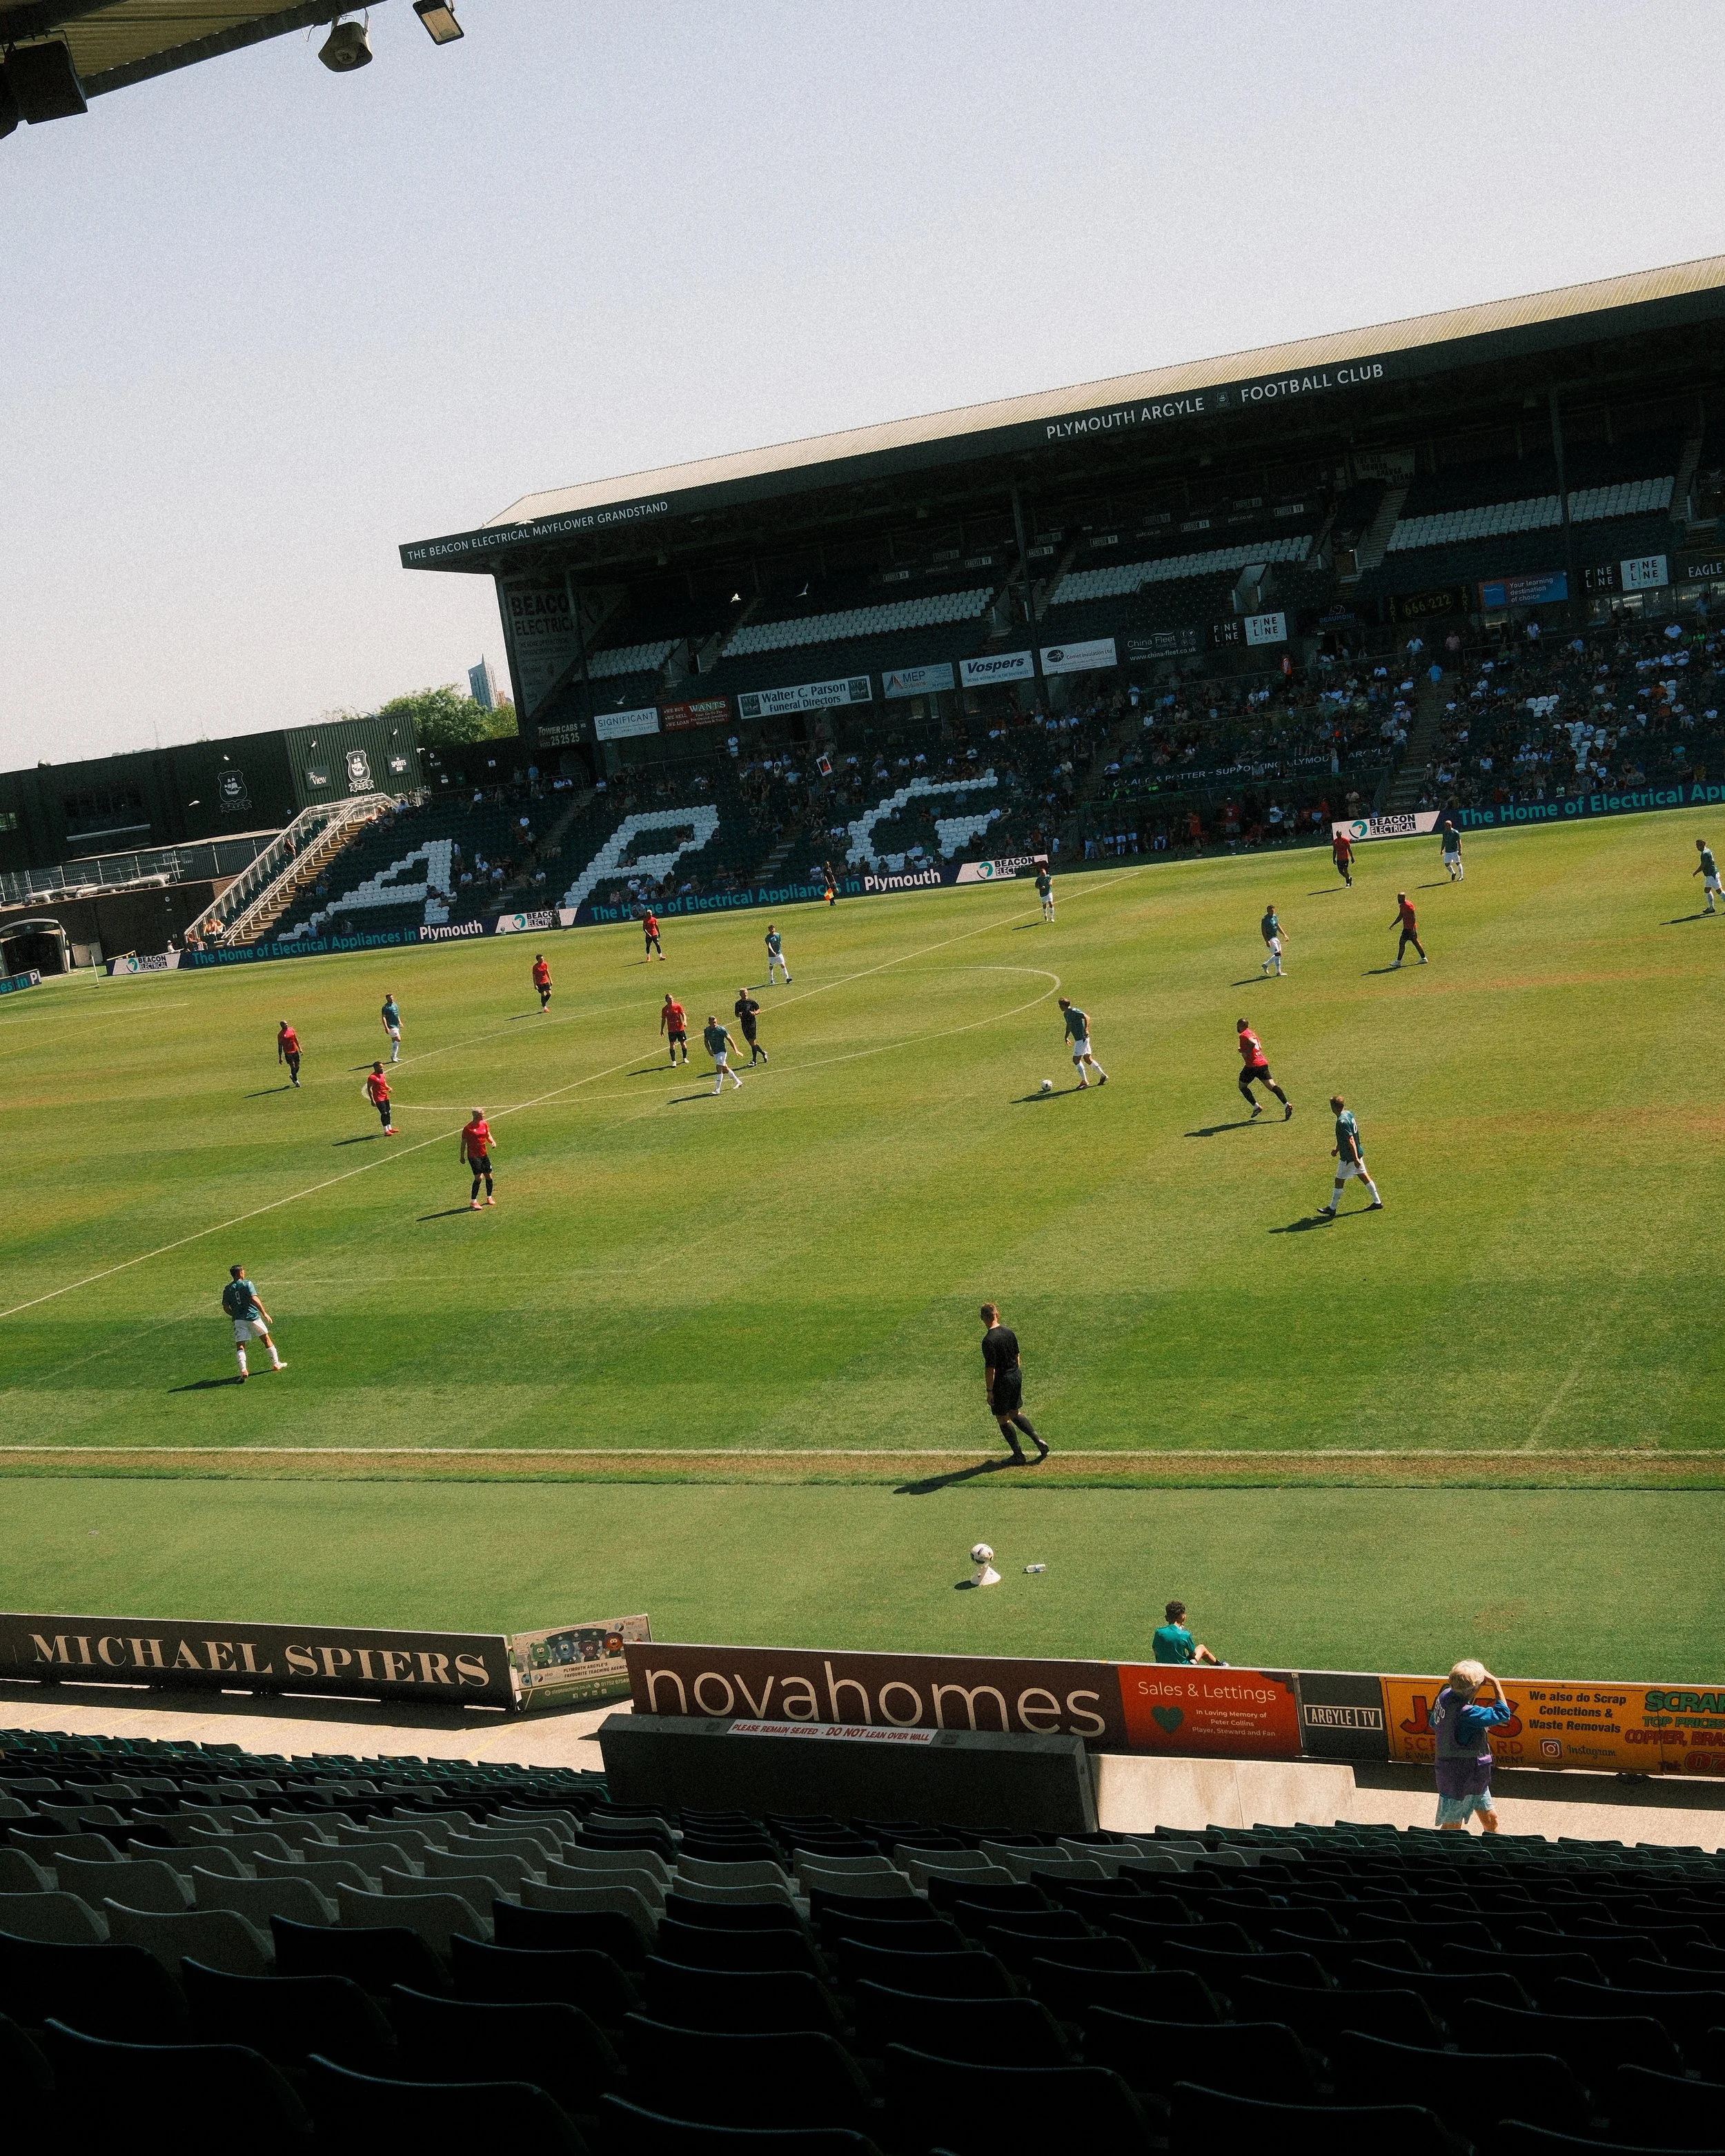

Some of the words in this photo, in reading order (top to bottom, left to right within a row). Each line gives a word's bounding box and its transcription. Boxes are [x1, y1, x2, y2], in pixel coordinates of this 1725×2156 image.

[1046, 409, 1136, 439] PLYMOUTH
[1141, 396, 1205, 422] ARGYLE
[1241, 373, 1332, 403] FOOTBALL
[1337, 363, 1384, 384] CLUB
[407, 548, 427, 560] THE
[429, 540, 469, 556] BEACON
[472, 528, 530, 548] ELECTRICAL
[533, 515, 594, 536] MAYFLOWER
[597, 501, 668, 524] GRANDSTAND
[1688, 562, 1723, 578] EAGLE
[1509, 582, 1525, 590] Your
[1526, 576, 1554, 589] learning
[1510, 585, 1547, 596] destination
[1460, 586, 1468, 612] TAXI
[1519, 593, 1541, 602] choice
[1388, 597, 1397, 623] TAXI
[1127, 639, 1152, 648] China
[1154, 635, 1176, 644] Fleet
[1082, 650, 1104, 658] Insulation
[1130, 646, 1197, 661] www.china-fleet.co.uk
[967, 657, 1025, 674] Vospers
[903, 671, 926, 683] MEP
[762, 691, 795, 703] Walter
[798, 687, 809, 698] C.
[811, 682, 847, 696] Parson
[689, 700, 727, 713] WANTS
[769, 701, 800, 713] Funeral
[803, 695, 842, 708] Directors
[598, 712, 654, 727] SIGNIFICANT
[538, 726, 561, 737] TOWER
[561, 723, 578, 733] CABS
[550, 735, 560, 746] 25
[560, 733, 570, 744] 25
[570, 732, 580, 743] 25
[312, 775, 327, 785] View
[1459, 809, 1494, 826] The
[1500, 804, 1558, 822] Home
[1564, 795, 1585, 815] of
[1590, 788, 1684, 812] Electrical
[1369, 813, 1416, 827] BEACON
[1370, 822, 1417, 835] ELECTRICAL
[994, 856, 1036, 868] BEACON
[591, 905, 618, 921] The
[622, 900, 663, 918] Hme
[667, 897, 682, 912] of
[686, 889, 753, 911] Electrical
[759, 883, 842, 903] Appliancs
[845, 877, 861, 893] in
[864, 869, 941, 892] Plymouth
[192, 951, 216, 965] The
[218, 946, 254, 962] Home
[257, 944, 269, 958] of
[273, 937, 328, 956] Electrical
[332, 931, 400, 950] Appliances
[404, 927, 416, 941] in
[420, 920, 483, 941] Plymouth
[138, 954, 167, 964] BEACON
[139, 961, 168, 971] ELECTRICAL
[16, 976, 28, 989] in
[28, 1634, 273, 1674] MICHAEL
[284, 1643, 490, 1688] SPIERS
[563, 1665, 586, 1673] PLYMOUTH
[645, 1661, 1106, 1737] novahomes
[1138, 1681, 1183, 1697] Sales
[1187, 1683, 1200, 1697] &
[1204, 1683, 1276, 1703] Lettings
[1529, 1691, 1546, 1701] We
[1549, 1692, 1573, 1702] also
[1576, 1692, 1590, 1703] do
[1593, 1693, 1626, 1706] Scrap
[1204, 1709, 1228, 1718] Loving
[1229, 1711, 1259, 1719] Memory
[1311, 1708, 1352, 1725] ARGYLE
[1361, 1710, 1375, 1726] TV
[1539, 1705, 1601, 1718] Collections
[1604, 1708, 1613, 1719] &
[1529, 1719, 1564, 1730] Waste
[1566, 1720, 1621, 1734] Removals
[1642, 1716, 1673, 1728] TOP
[731, 1723, 761, 1732] PLEASE
[760, 1725, 790, 1733] REMAIN
[790, 1726, 818, 1735] SEATED
[825, 1727, 841, 1737] DO
[842, 1727, 866, 1737] NOT
[865, 1730, 887, 1739] LEAN
[887, 1732, 909, 1740] OVER
[909, 1732, 930, 1741] WALL
[1192, 1726, 1216, 1734] Player,
[1625, 1729, 1688, 1747] COPPER,
[1566, 1744, 1617, 1759] Instagram
